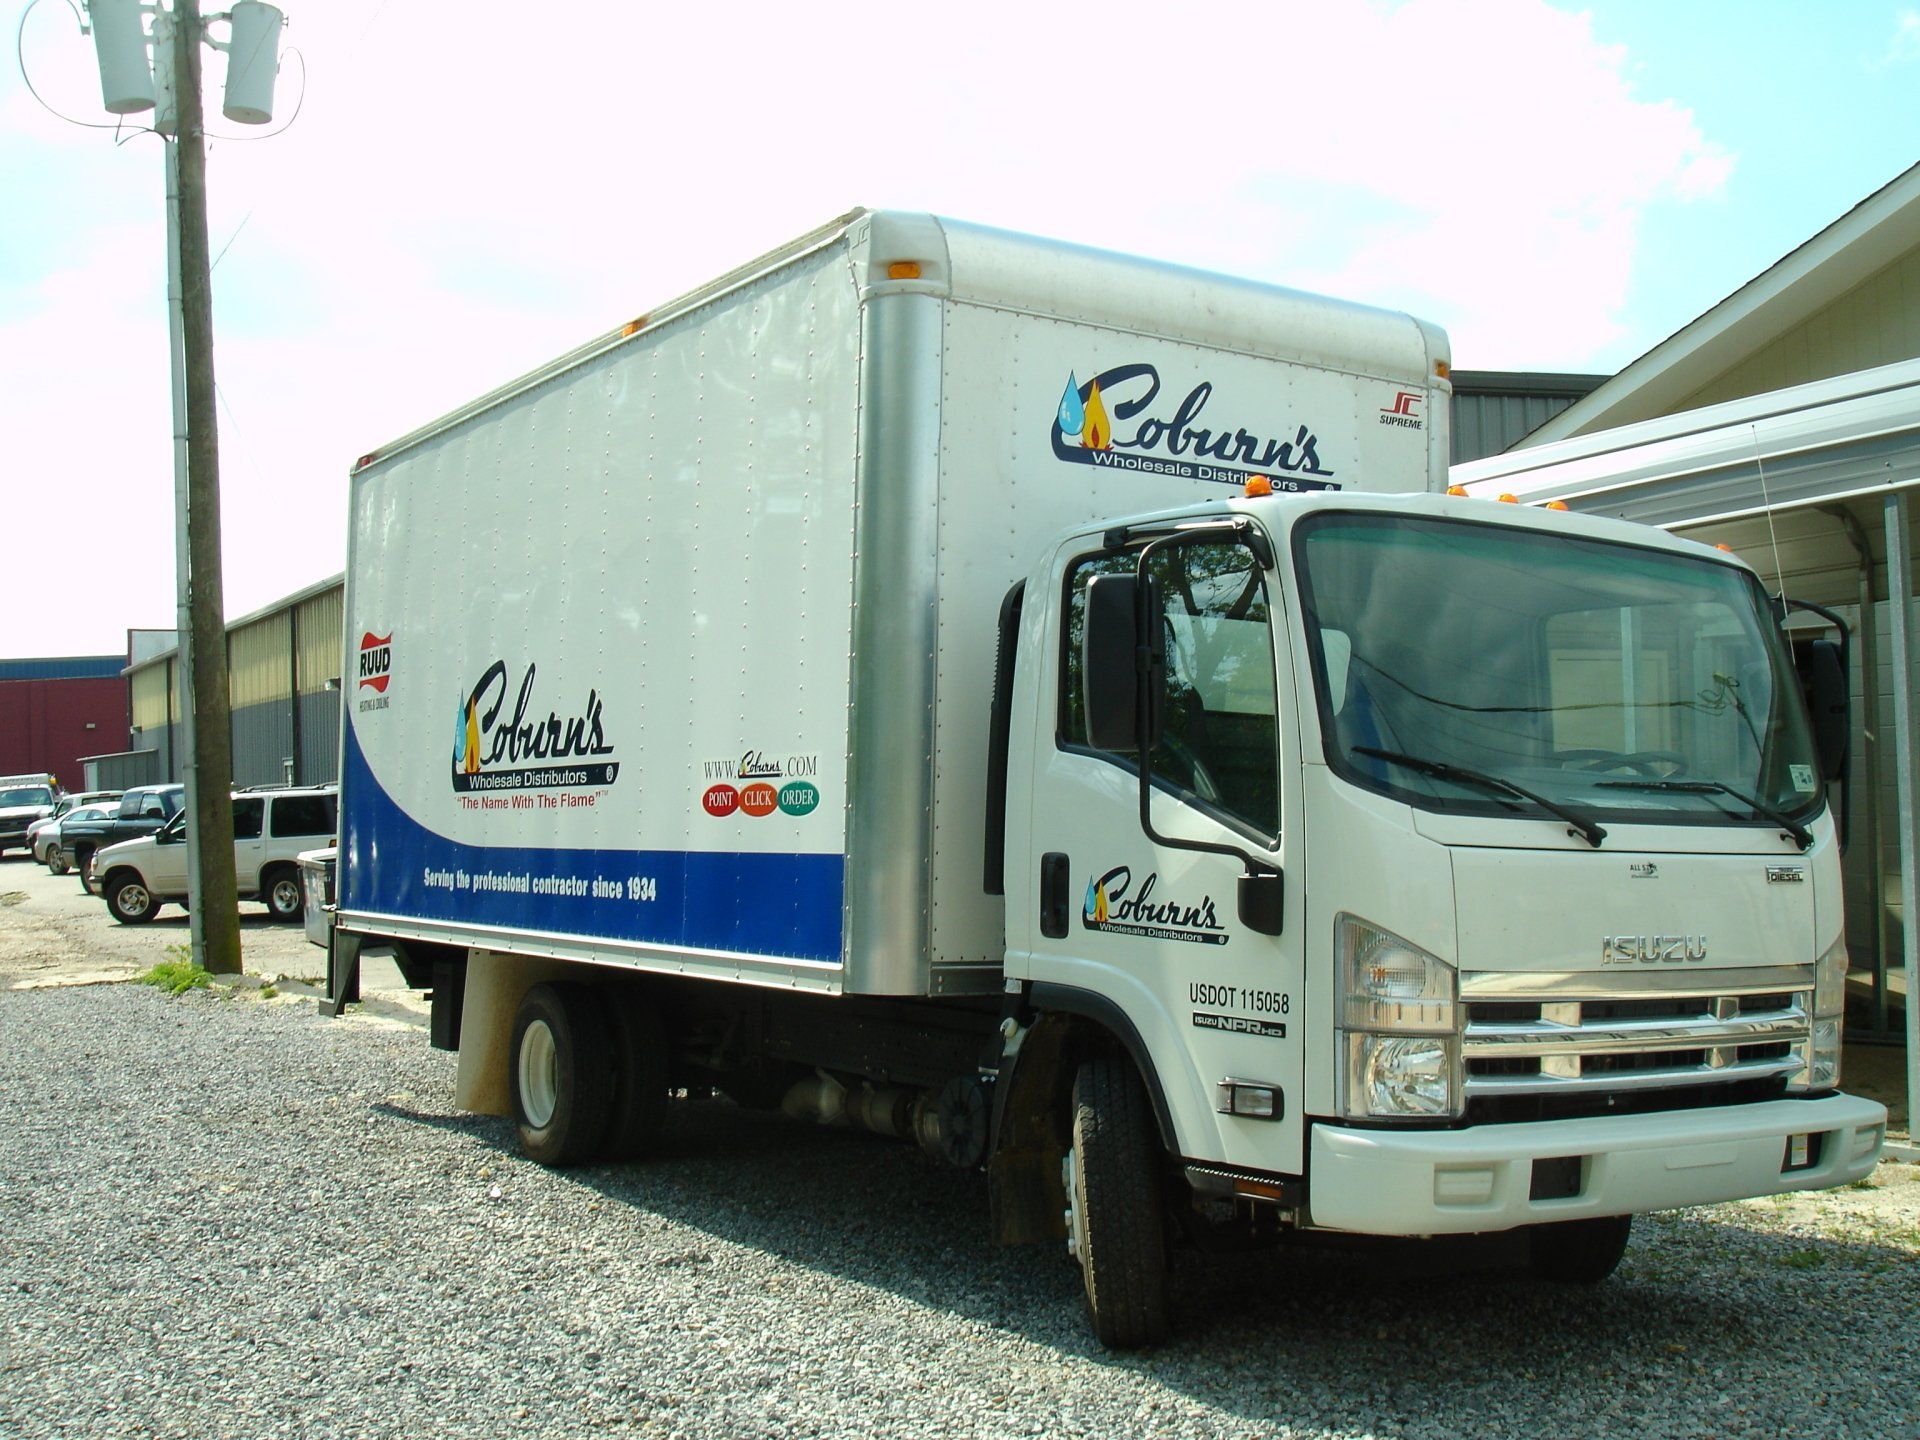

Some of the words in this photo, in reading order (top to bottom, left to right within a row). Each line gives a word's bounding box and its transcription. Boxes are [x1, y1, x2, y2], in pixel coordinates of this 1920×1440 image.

[1051, 363, 1334, 476] Coburn's
[1379, 414, 1423, 430] SUPREME
[1092, 451, 1192, 477] Wholesale
[1199, 466, 1298, 492] Distriors
[360, 647, 391, 677] RUUD
[452, 659, 614, 770] Coburn's
[469, 773, 521, 790] Wholesale
[524, 770, 588, 786] Distributors
[481, 796, 508, 810] Name
[512, 795, 534, 809] With
[537, 794, 557, 809] The
[708, 791, 734, 807] POINT
[744, 790, 772, 806] CLICK
[781, 789, 814, 805] ORDER
[424, 867, 454, 892] Serving
[456, 870, 470, 889] the
[473, 871, 530, 893] professional
[532, 875, 589, 896] contractor
[592, 875, 623, 899] since
[627, 877, 657, 901] 1934
[1770, 873, 1804, 882] DIESEL
[1083, 865, 1225, 930] Coburn's
[1100, 922, 1146, 936] Wholesale
[1148, 928, 1203, 943] Distributors
[1603, 935, 1707, 964] ISUZU
[1190, 982, 1237, 1008] USDOT
[1241, 989, 1290, 1015] 115058
[1195, 1016, 1218, 1026] ISUZU
